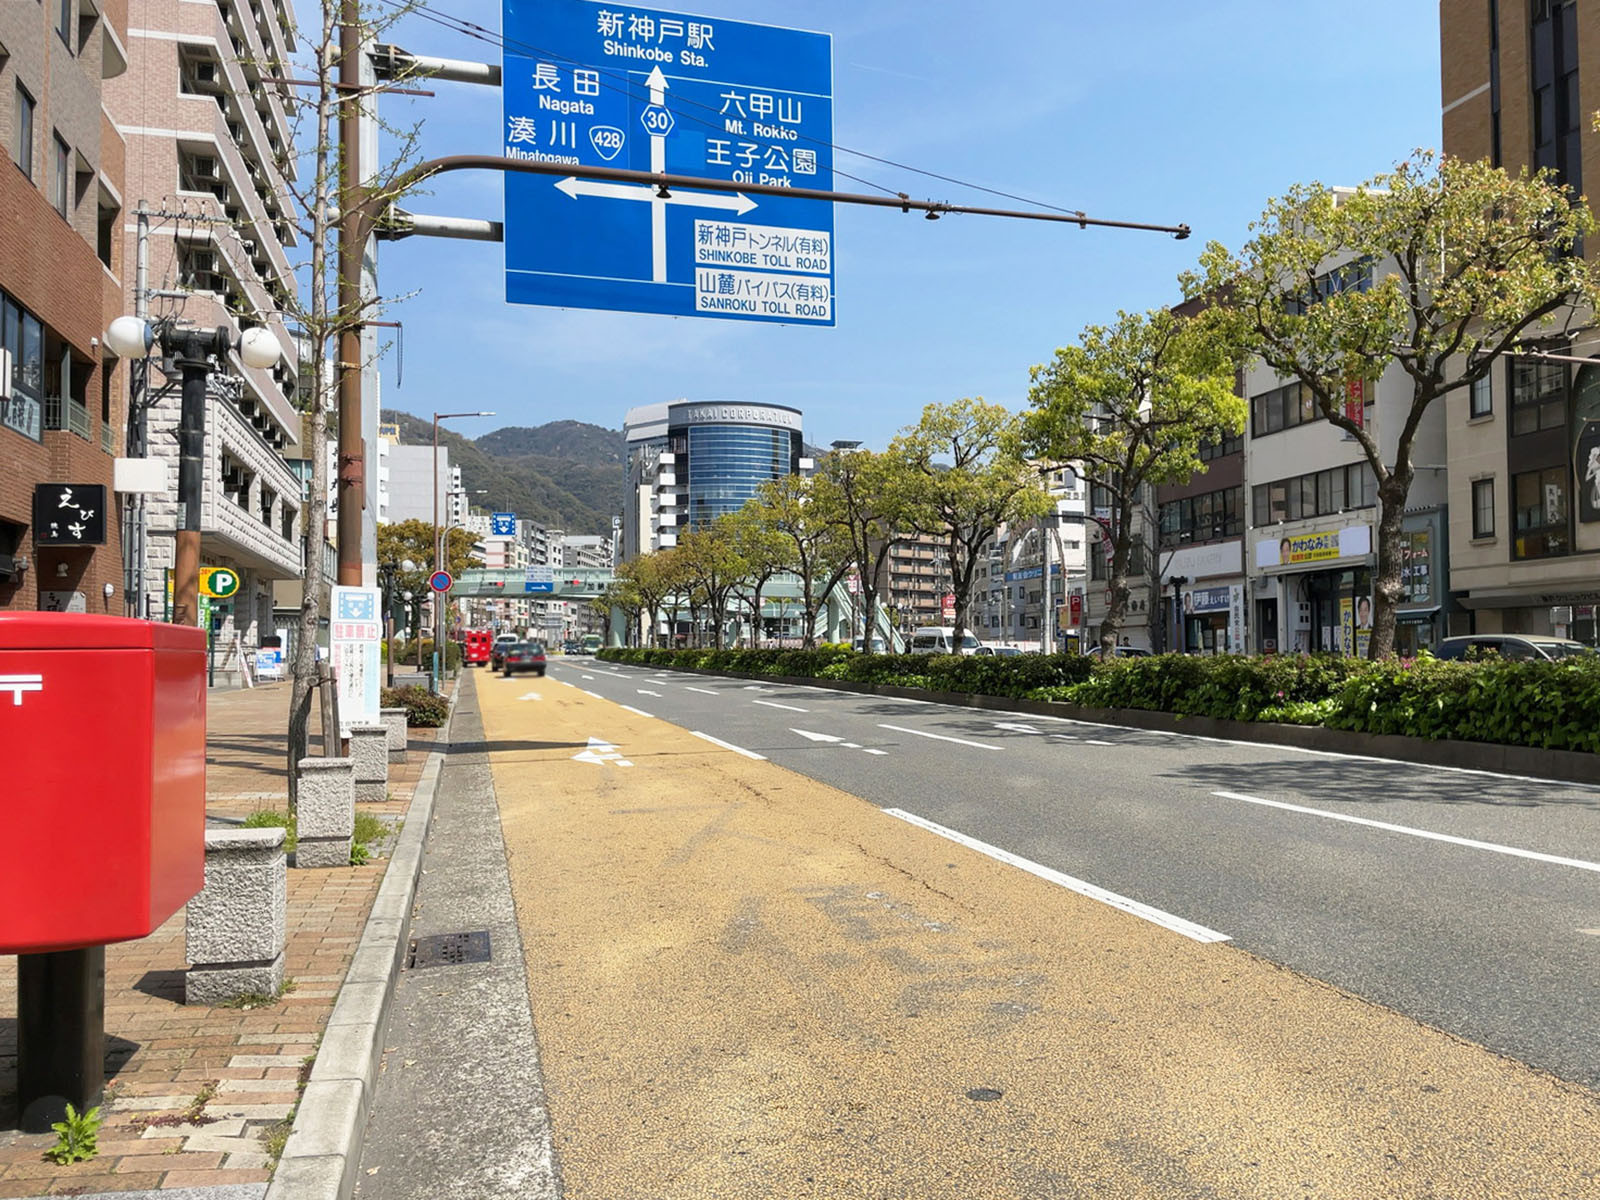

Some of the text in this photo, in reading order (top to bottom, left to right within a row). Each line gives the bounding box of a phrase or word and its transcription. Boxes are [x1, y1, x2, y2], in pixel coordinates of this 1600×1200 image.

[597, 10, 715, 51] 新神戸駅
[603, 40, 709, 68] Shinkobe Sta.
[532, 63, 599, 96] 長田
[539, 94, 594, 116] Nagata
[719, 90, 802, 124] 六甲山
[647, 111, 668, 129] 30
[725, 119, 798, 141] Mt. Rokko
[507, 115, 576, 149] 湊川
[594, 131, 620, 149] 428
[505, 146, 580, 166] Minatogawa
[706, 138, 816, 175] 王子公園
[759, 173, 792, 188] Park
[698, 223, 829, 256] 新神戸トンネル(有料)
[698, 248, 827, 270] SHINKOBE TOLL ROAD
[699, 271, 829, 303] 山麓バイパス(有料)
[700, 296, 827, 317] SANROKU TOLL ROAD
[215, 573, 233, 593] P
